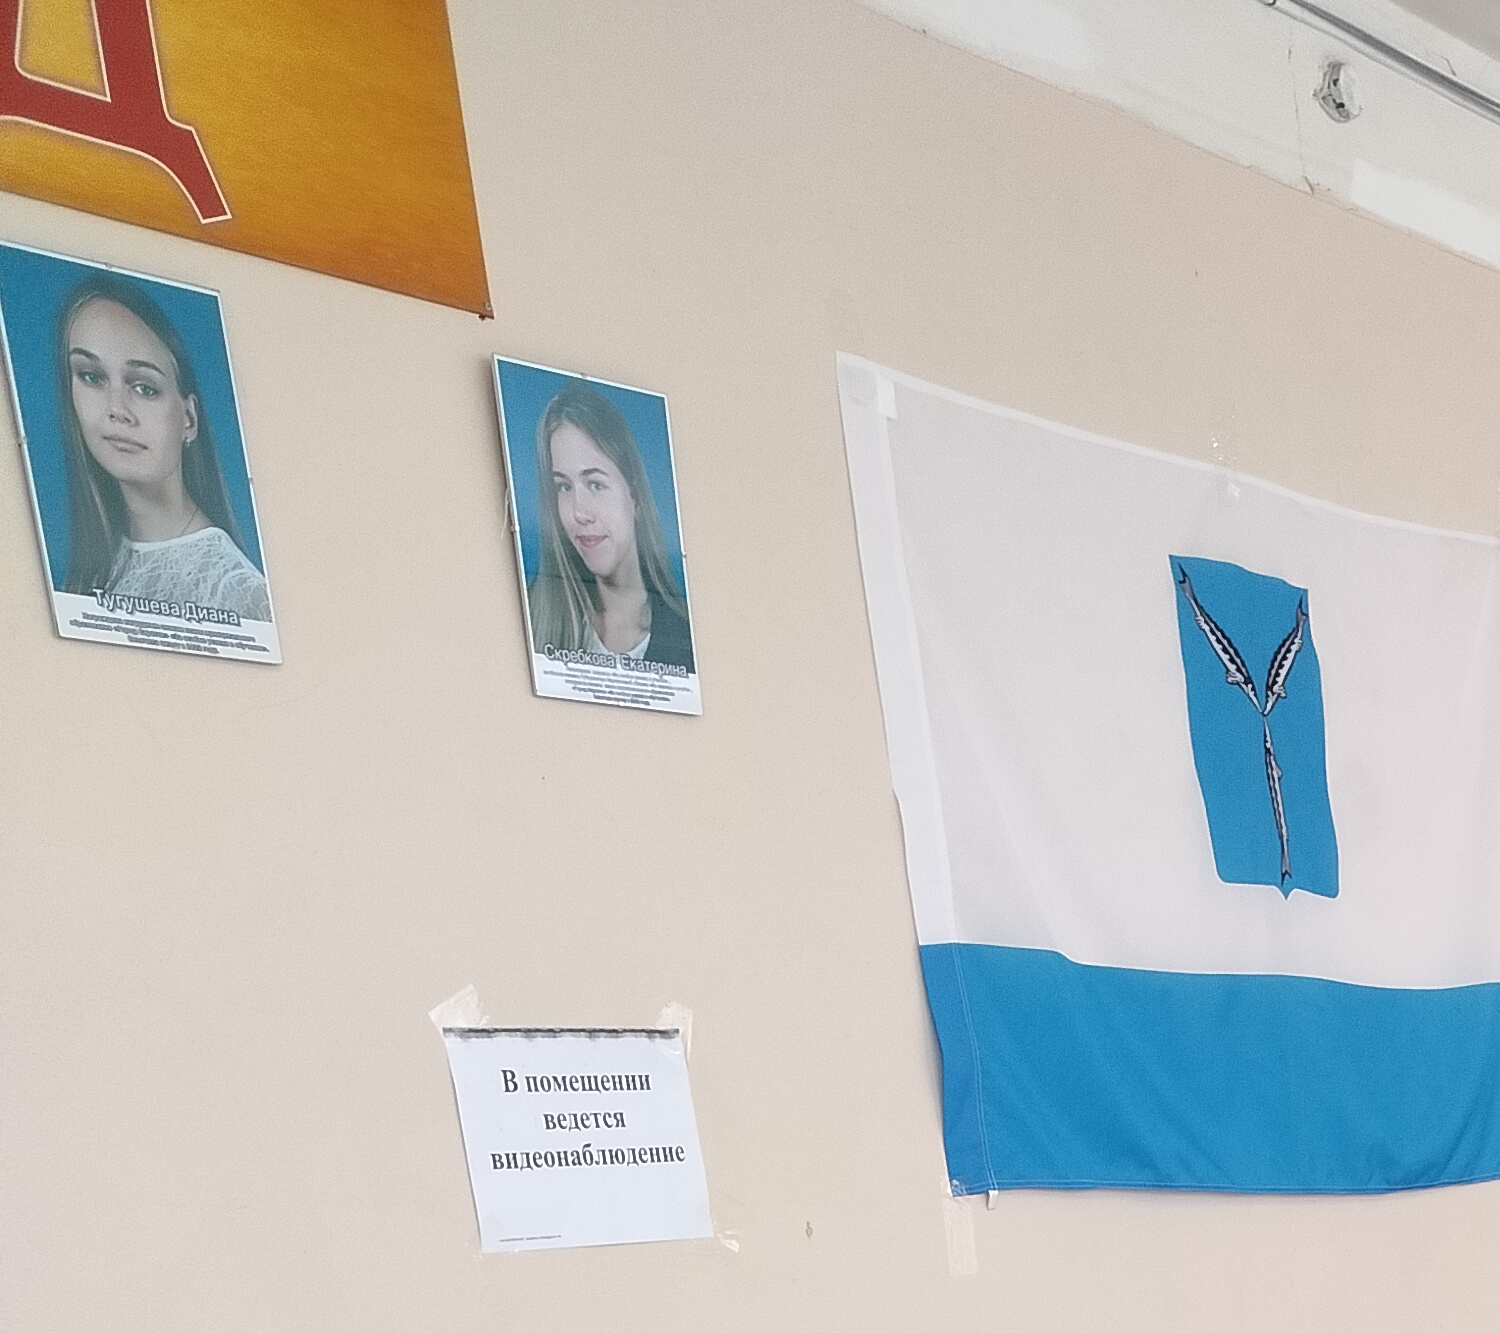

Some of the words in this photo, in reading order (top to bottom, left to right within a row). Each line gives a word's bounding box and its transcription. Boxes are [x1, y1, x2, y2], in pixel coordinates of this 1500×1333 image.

[92, 588, 181, 617] Тугушева
[184, 602, 240, 625] Диана
[544, 643, 616, 667] Скребкова
[619, 654, 689, 679] Екатерина
[501, 1068, 519, 1093] В
[524, 1071, 652, 1094] помещении
[542, 1111, 627, 1132] ведется
[490, 1142, 686, 1171] видеонаблюдение
